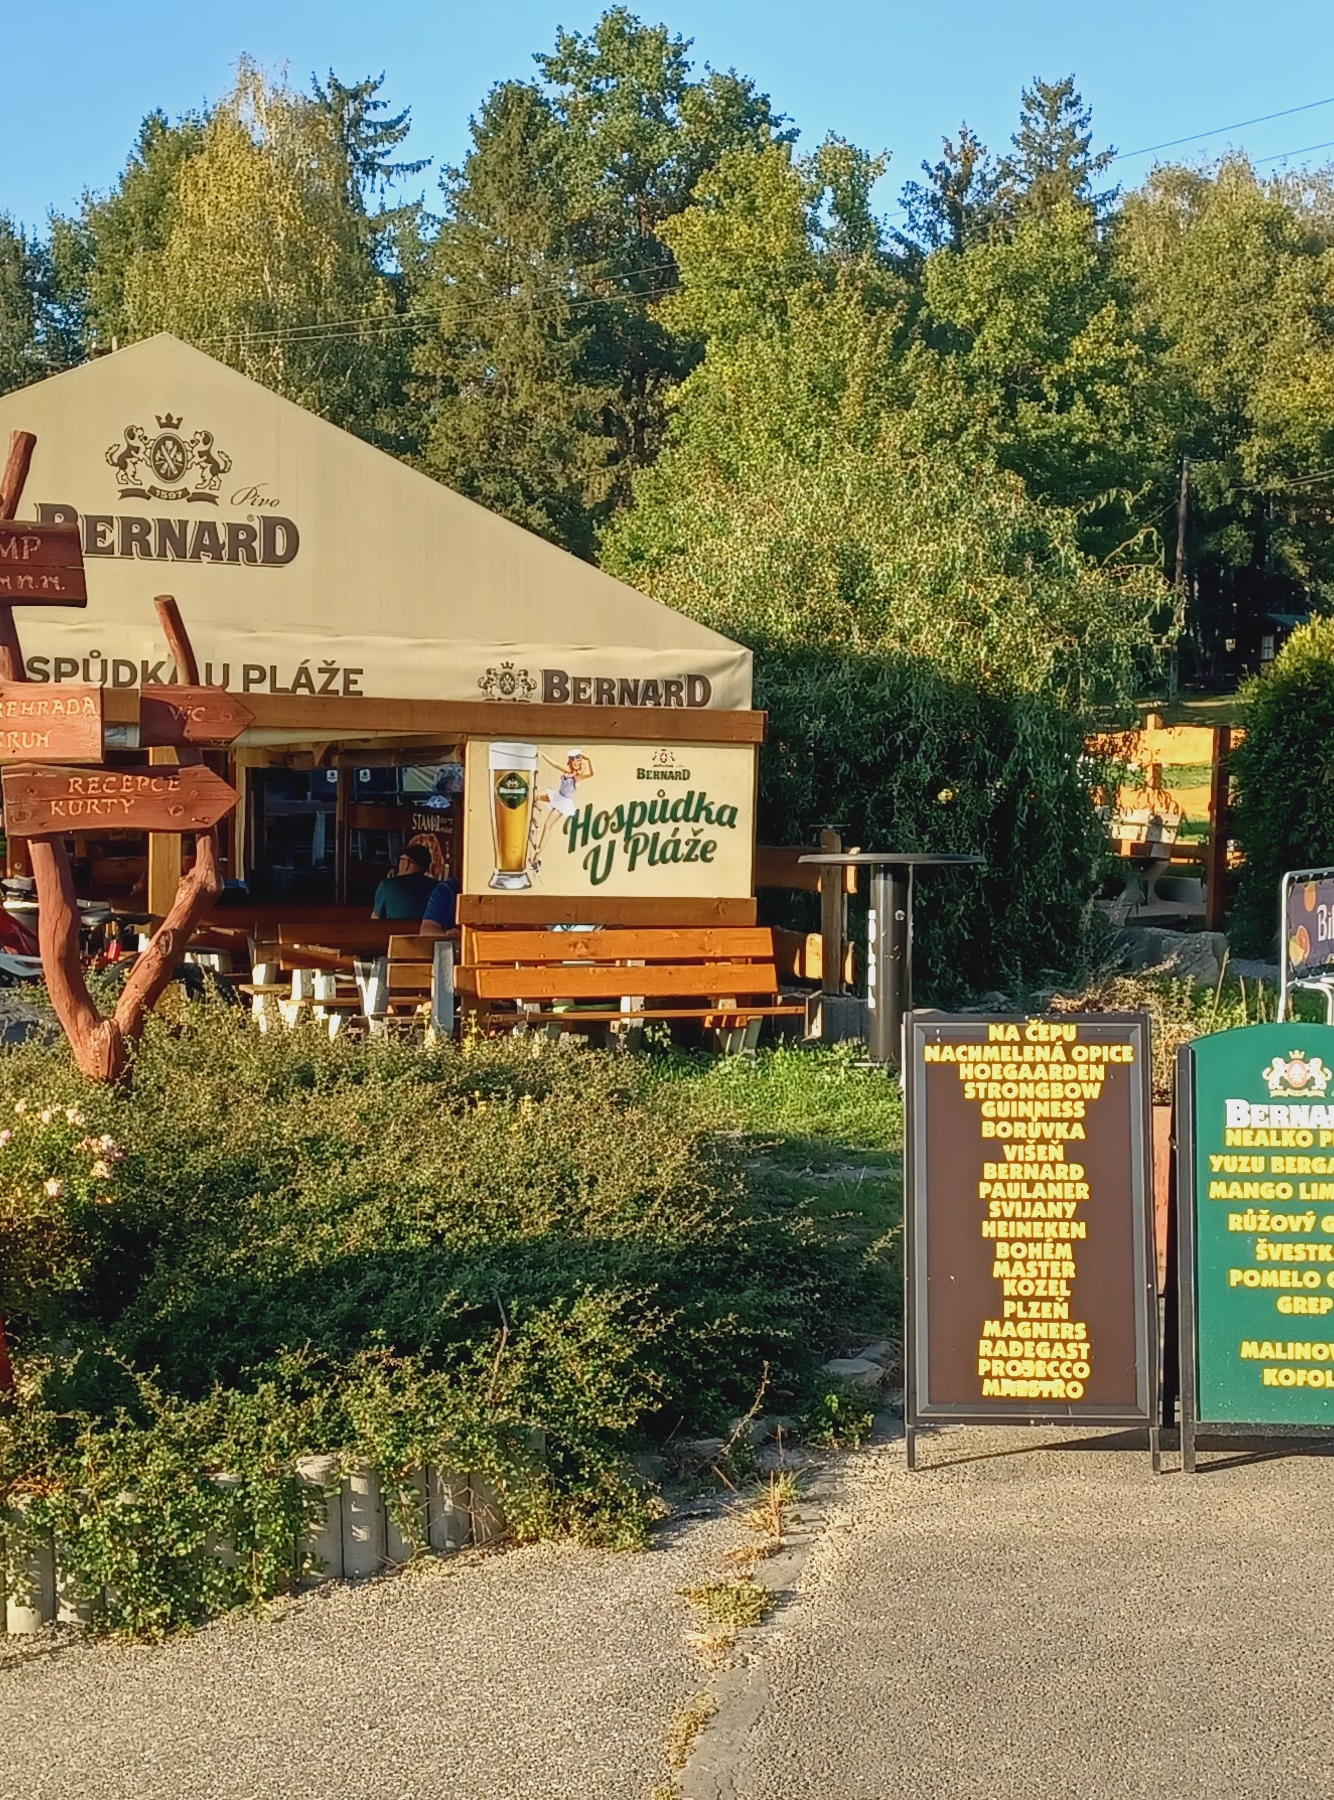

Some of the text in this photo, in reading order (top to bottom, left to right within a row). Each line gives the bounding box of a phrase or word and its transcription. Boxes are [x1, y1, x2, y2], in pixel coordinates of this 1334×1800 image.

[155, 489, 184, 500] 1597
[230, 483, 281, 508] Pivo
[205, 662, 230, 690] U
[243, 658, 364, 697] PLÁŽE
[540, 669, 712, 709] BERNARD
[169, 705, 206, 722] WC
[636, 768, 691, 781] BERNARD
[68, 774, 182, 795] RECEPCE
[50, 798, 135, 816] KURTY
[563, 789, 739, 854] Hospůdka
[583, 827, 717, 886] U Pláže
[988, 1019, 1077, 1042] NA ČEPU
[924, 1041, 1134, 1062] NACHMELENÁ OPICE
[959, 1064, 1105, 1080] HOEGAARDEN
[964, 1083, 1101, 1099] STRONGBOW
[981, 1101, 1085, 1118] GUINNESS
[982, 1115, 1085, 1139] BORŮVKA
[1225, 1130, 1313, 1147] NEALKO
[1003, 1140, 1064, 1161] VIŠEŇ
[983, 1163, 1084, 1180] BERNARD
[1209, 1155, 1265, 1173] YUZU
[979, 1182, 1089, 1199] PAULANER
[1209, 1182, 1293, 1199] MANGO
[989, 1201, 1077, 1218] SVIJANY
[982, 1221, 1086, 1238] HEINEKEN
[1228, 1209, 1316, 1232] RŮŽOVÝ
[996, 1239, 1072, 1260] BOHÉM
[993, 1261, 1076, 1278] MASTER
[1229, 1269, 1321, 1288] POMELO
[1003, 1279, 1071, 1296] KOZEL
[1003, 1297, 1068, 1319] PLZEŇ
[1277, 1296, 1334, 1314] GREP
[983, 1321, 1087, 1340] MAGNERS
[979, 1340, 1090, 1359] RADEGAST
[978, 1359, 1090, 1378] PROSECCO
